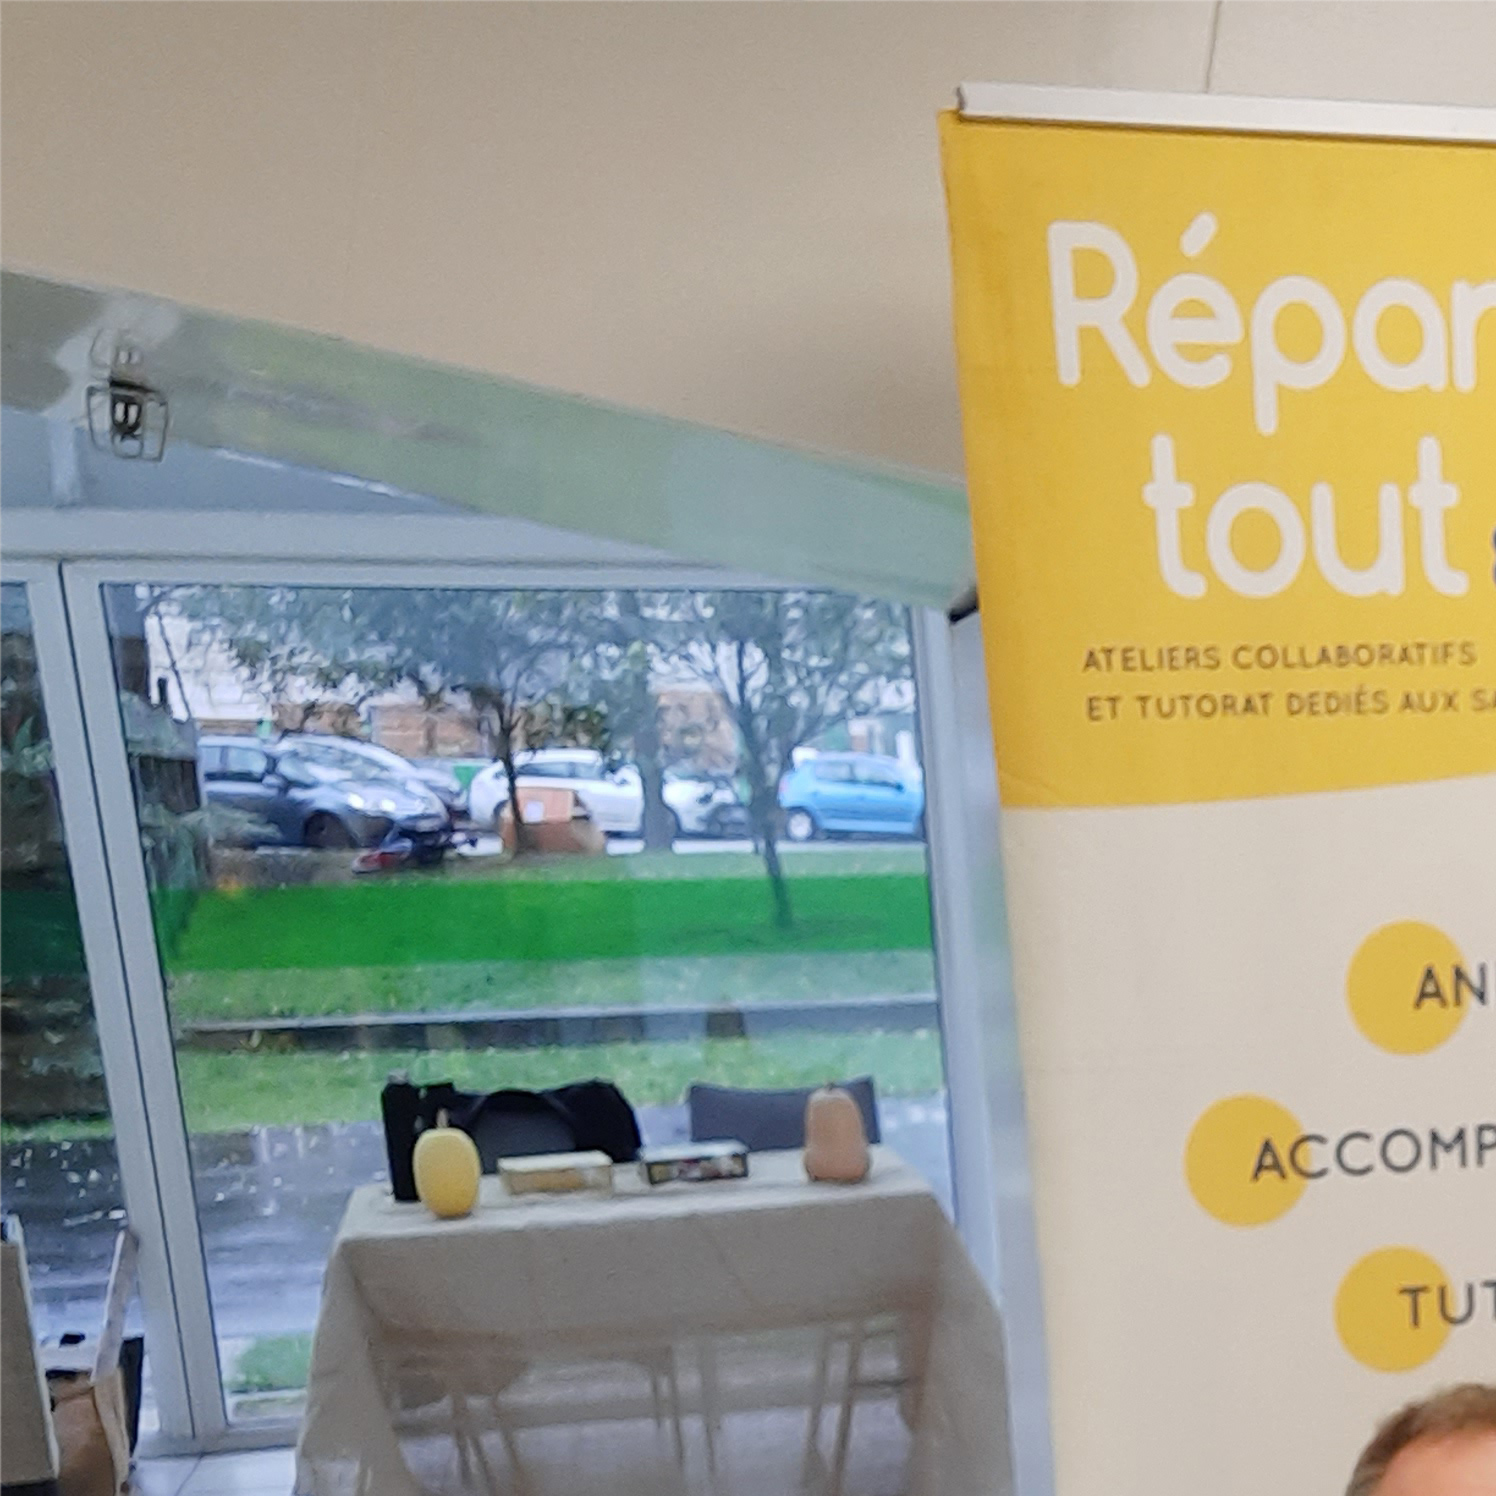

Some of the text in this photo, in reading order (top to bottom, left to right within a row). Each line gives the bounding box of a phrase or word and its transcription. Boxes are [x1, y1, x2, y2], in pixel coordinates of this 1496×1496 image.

[1143, 433, 1469, 598] tout
[1083, 641, 1478, 673] ATELIERS COLLABORATIFS
[1086, 695, 1122, 722] ET
[1139, 692, 1275, 719] TUTORAT
[1401, 689, 1460, 714] AUX
